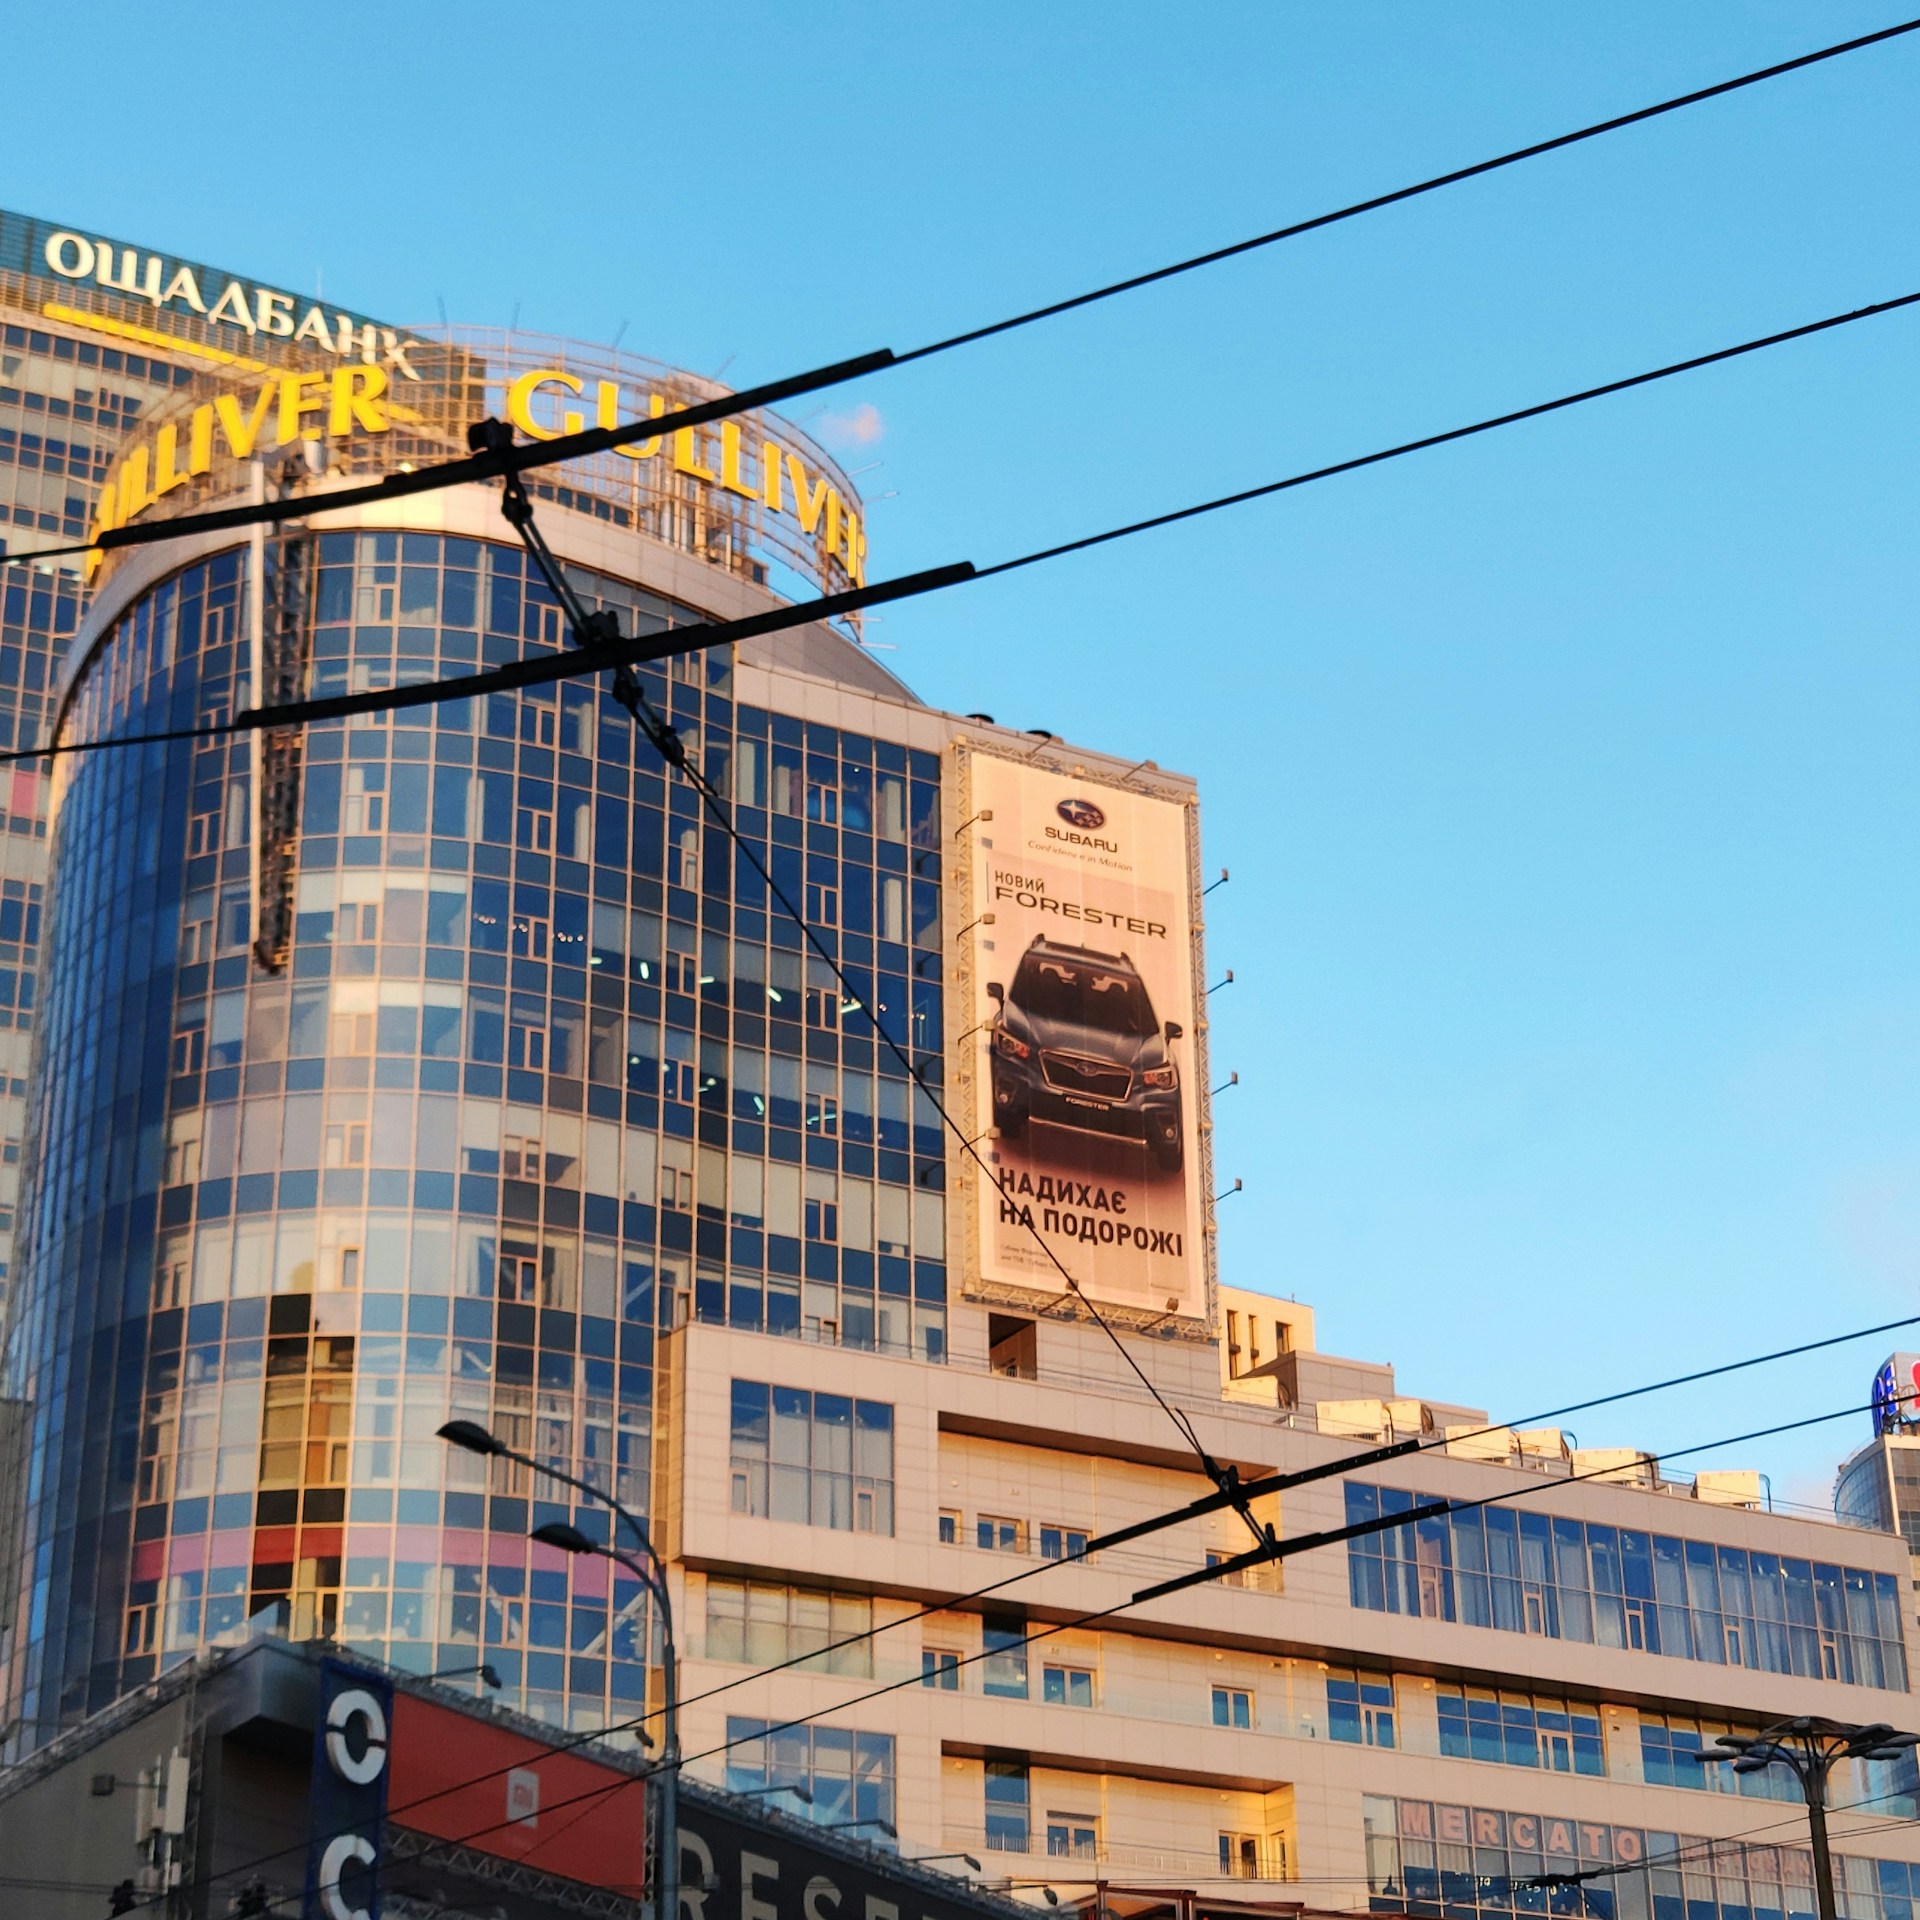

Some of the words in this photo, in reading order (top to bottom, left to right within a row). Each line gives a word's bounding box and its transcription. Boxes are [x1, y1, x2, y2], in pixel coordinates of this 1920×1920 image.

[45, 232, 422, 382] ОЩАДБАНК
[1044, 826, 1118, 853] SUBARU
[1098, 858, 1133, 872] Motion
[994, 870, 1045, 894] НОВИЙ
[995, 886, 1167, 940] FORESTER
[999, 1167, 1127, 1215] НАДИХАЄ
[1000, 1199, 1035, 1230] НА
[1043, 1208, 1183, 1257] ПОДОРОЖІ
[1401, 1800, 1643, 1862] MERCATO
